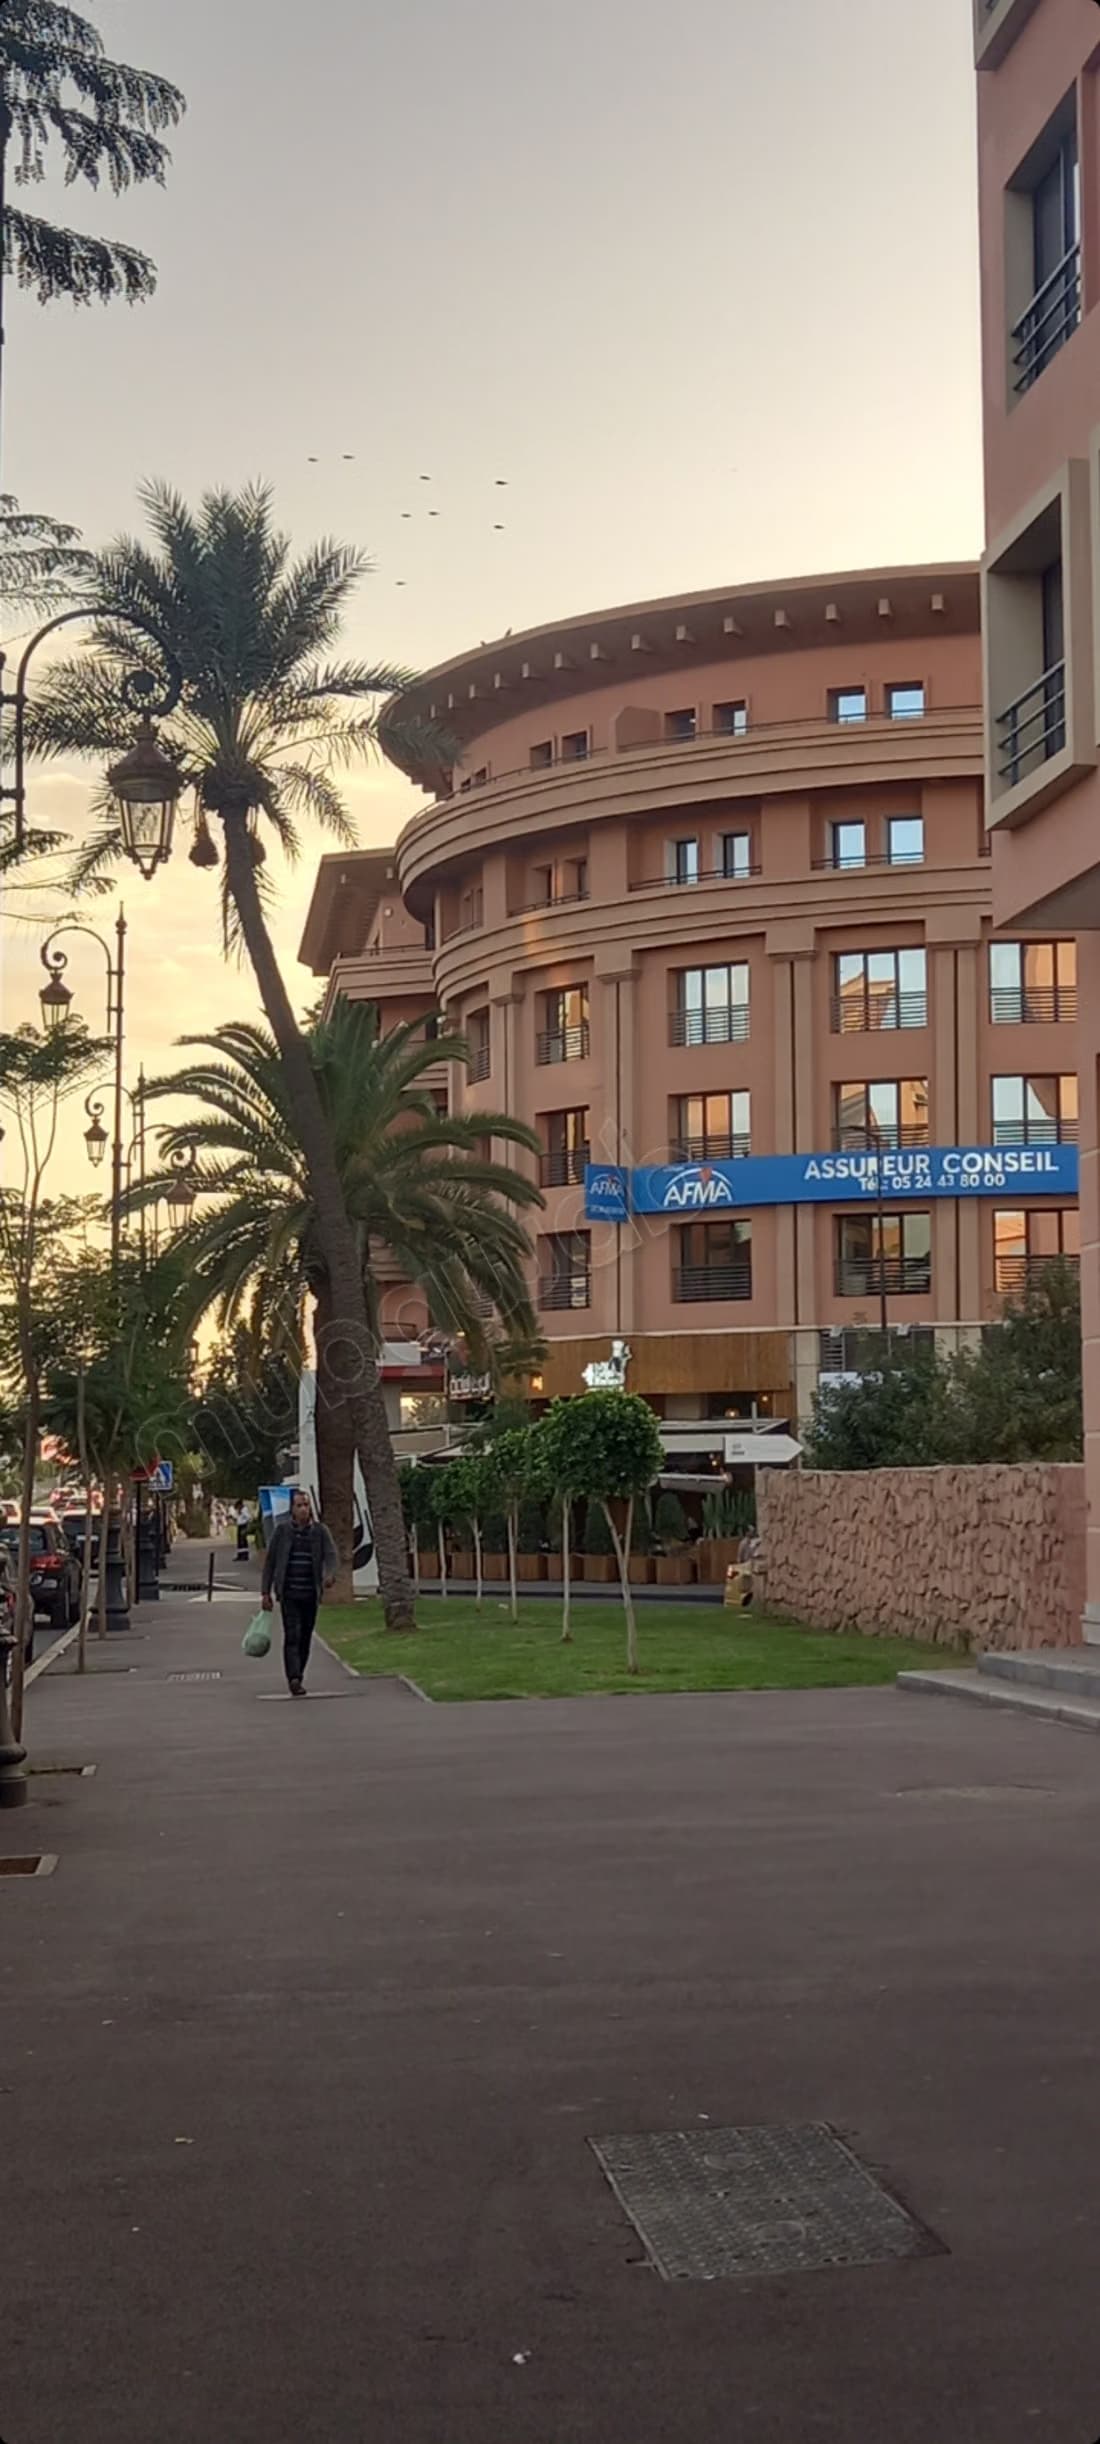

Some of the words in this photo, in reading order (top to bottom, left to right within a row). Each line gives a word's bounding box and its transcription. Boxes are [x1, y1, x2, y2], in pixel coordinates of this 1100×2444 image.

[804, 1154, 931, 1180] ASSUREUR
[943, 1152, 1060, 1174] CONSEIL
[589, 1180, 625, 1197] AFMA
[892, 1175, 911, 1190] 05
[915, 1175, 932, 1189] 24
[937, 1174, 955, 1188] 43
[960, 1174, 980, 1188] 80
[984, 1173, 1006, 1187] 00
[663, 1180, 733, 1208] AFMA
